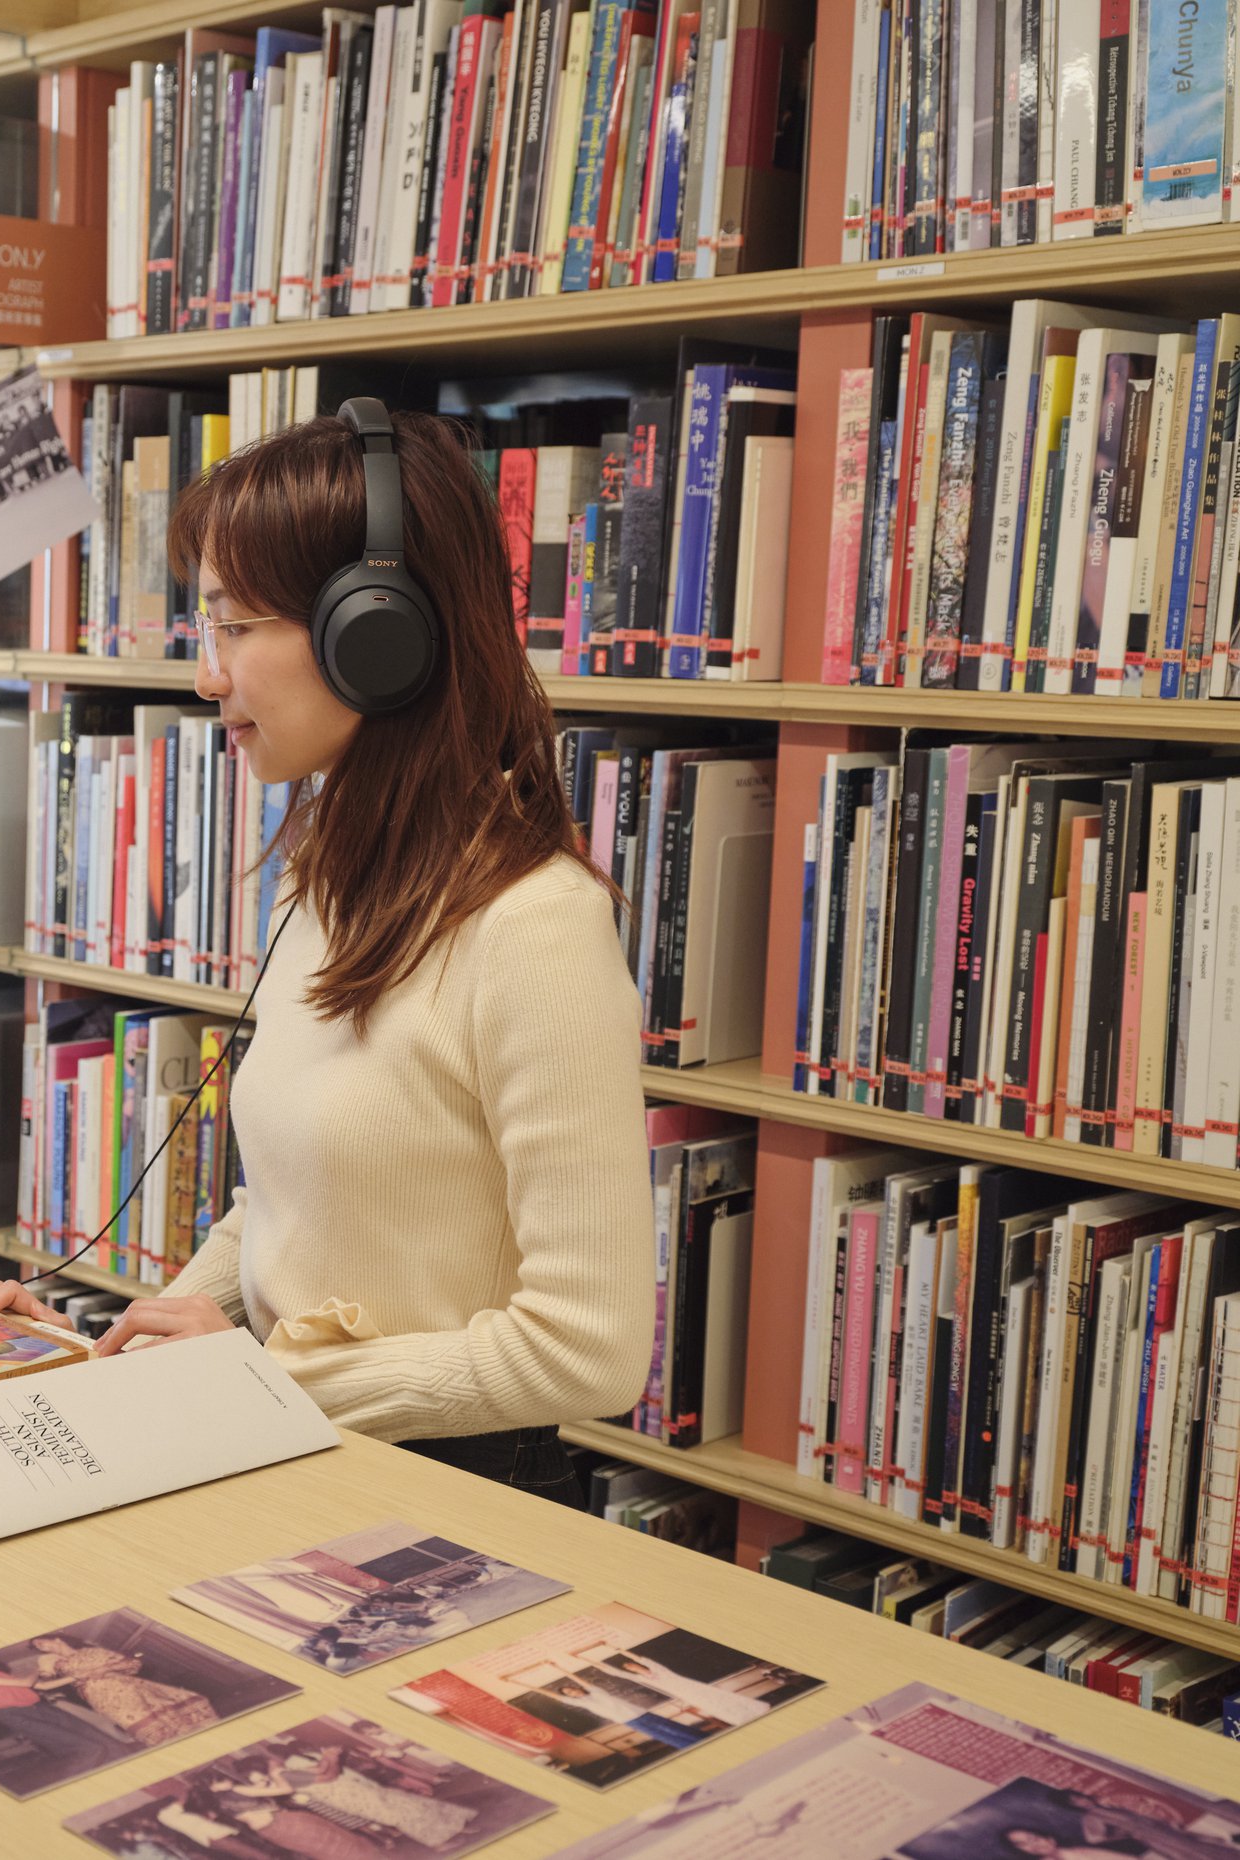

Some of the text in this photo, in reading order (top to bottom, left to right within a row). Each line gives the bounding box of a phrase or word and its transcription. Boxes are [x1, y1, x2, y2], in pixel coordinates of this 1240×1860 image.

[1169, 0, 1201, 94] Chunya
[525, 7, 551, 144] YOU HYEON KYEONG
[1106, 95, 1117, 121] Tchang
[1105, 122, 1116, 149] Tchong
[1069, 139, 1079, 208] PAUL CHIANG
[1105, 150, 1115, 162] Jen
[7, 278, 45, 292] ARTIST
[951, 366, 972, 408] Zeng
[689, 381, 712, 452] 姚瑞中
[916, 407, 925, 429] Zeng
[1104, 401, 1115, 441] Collection
[1003, 431, 1018, 463] Zeng
[1000, 465, 1015, 505] Fanzhi
[1071, 451, 1082, 486] Zhang
[1187, 458, 1196, 479] Zhao
[942, 478, 962, 523] Every
[1087, 467, 1113, 567] Zheng Guogu
[1181, 480, 1194, 526] Guanghui's
[941, 526, 958, 562] Mark
[1181, 527, 1189, 540] Art
[367, 559, 398, 568] SONY
[939, 565, 954, 589] Its
[935, 593, 952, 631] Mask
[617, 789, 630, 823] YOU
[964, 822, 979, 858] 失重
[1026, 831, 1040, 884] Zhang nian
[1100, 799, 1117, 921] ZHAO QIN MEMORANDUM
[1203, 869, 1212, 888] Zhang
[956, 877, 976, 971] Gravity Lost
[1129, 911, 1140, 976] NEW FOREST
[932, 979, 949, 1018] WIND
[953, 1016, 962, 1039] ZHANG
[1011, 990, 1026, 1061] Moving Memories
[1123, 1038, 1133, 1080] HISTORY
[853, 1227, 868, 1272] ZHANG
[1048, 1230, 1063, 1276] The Observer
[853, 1275, 865, 1292] YU
[918, 1281, 930, 1299] MY
[914, 1303, 931, 1341] HEART
[951, 1312, 964, 1352] ZHUANG
[1098, 1294, 1114, 1359] Zhang Jian-Jun
[913, 1345, 926, 1374] LAID
[950, 1353, 960, 1380] HONG
[1139, 1339, 1151, 1393] ZHU JINSHI
[1156, 1363, 1166, 1390] WATER
[844, 1347, 861, 1425] FINGERPRINTS
[13, 1424, 51, 1459] ASIAN
[22, 1411, 75, 1465] FEMINIST
[29, 1393, 102, 1475] DECLARATION
[872, 1425, 883, 1466] ZHANG
